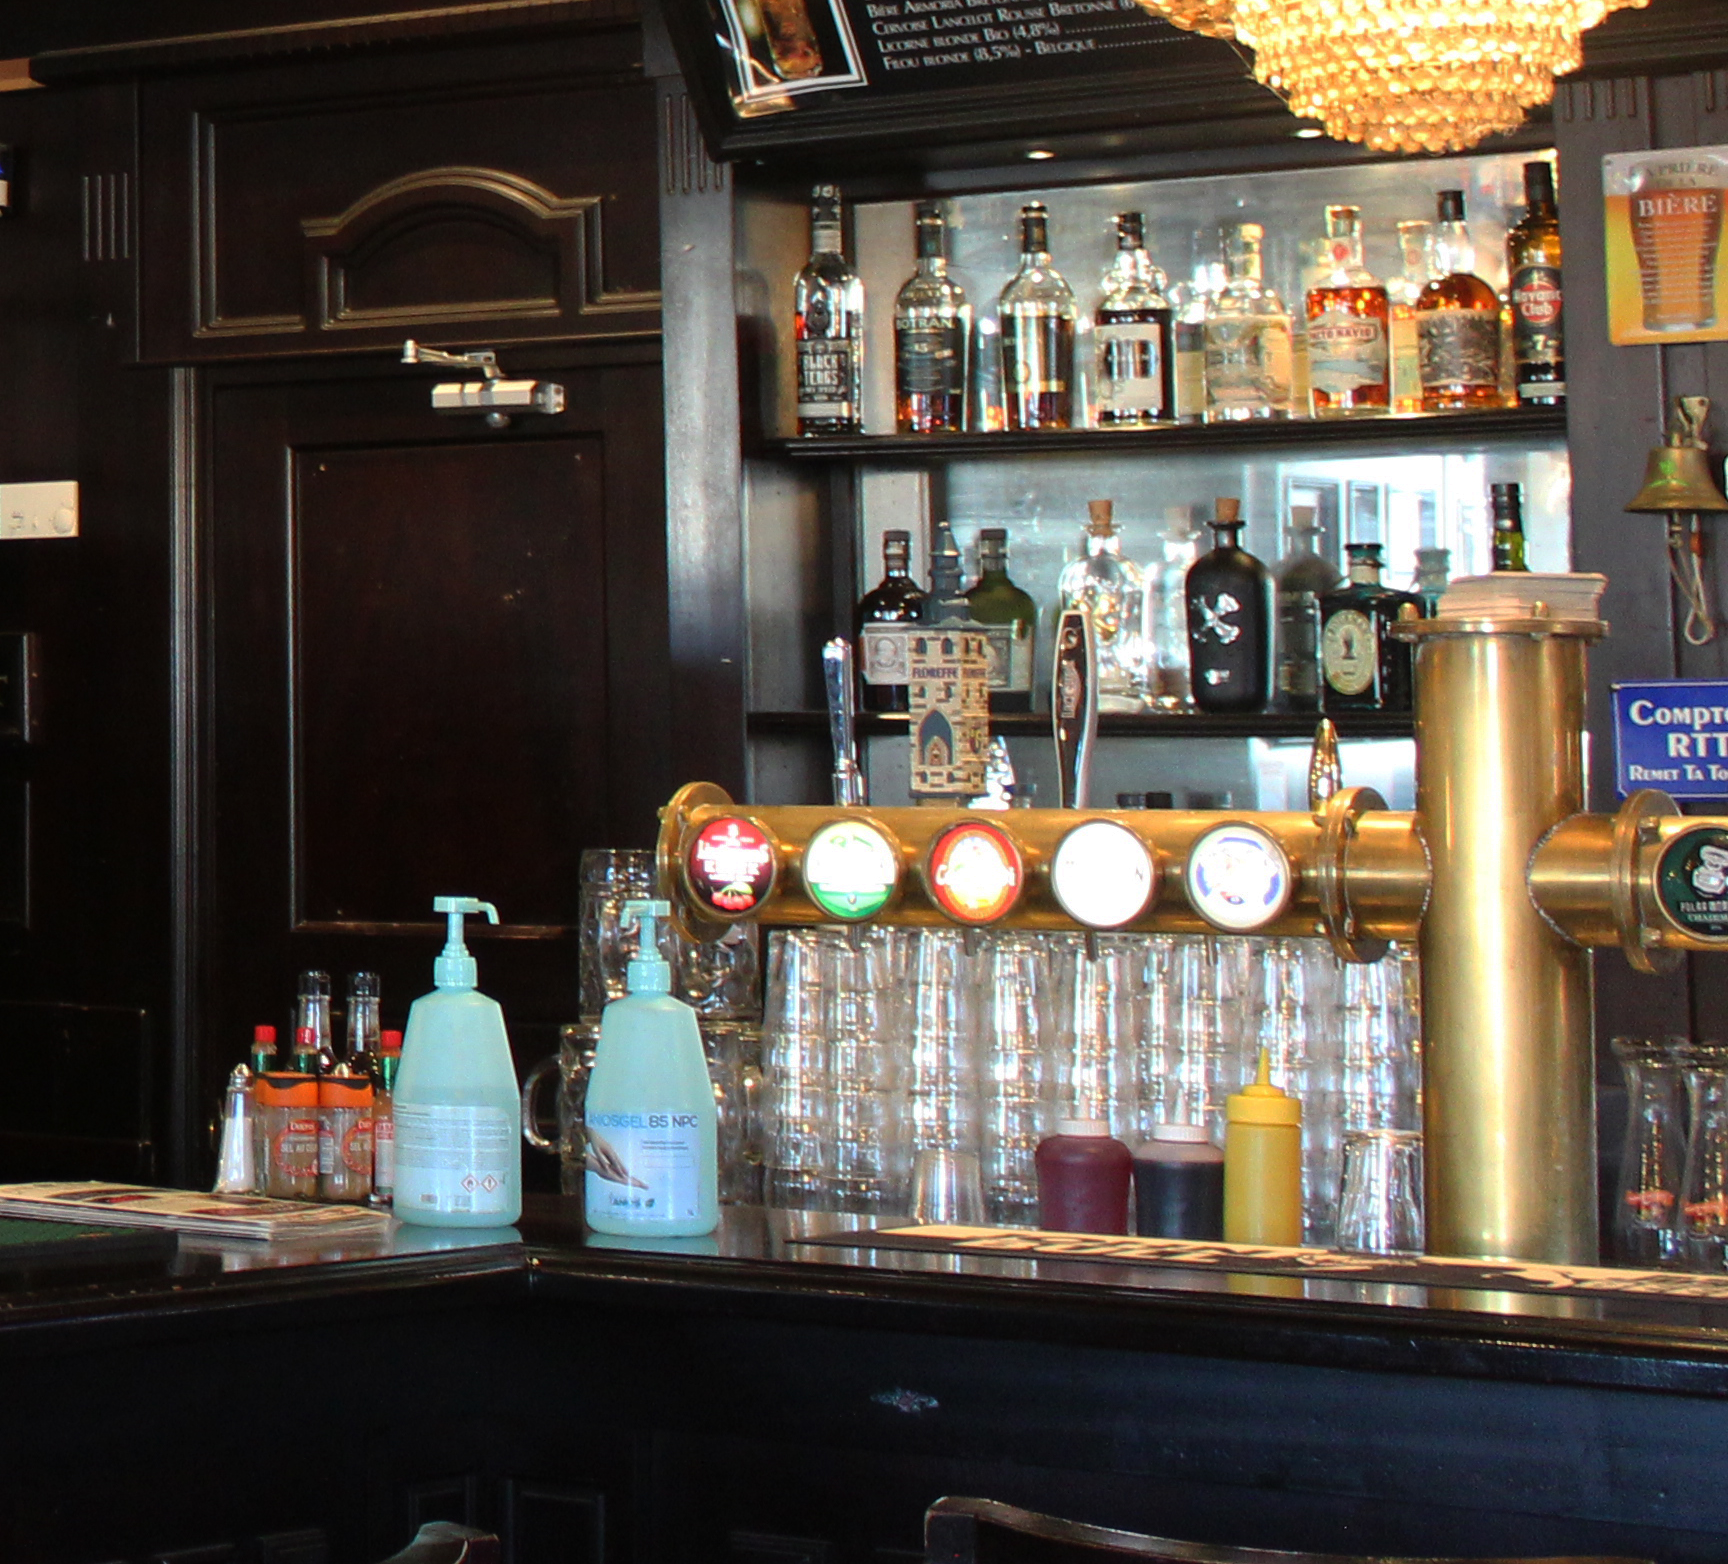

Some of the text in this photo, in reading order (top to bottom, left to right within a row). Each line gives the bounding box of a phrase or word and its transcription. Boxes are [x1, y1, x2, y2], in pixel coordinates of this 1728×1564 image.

[1638, 193, 1717, 217] BIÈRE
[648, 1115, 698, 1128] 85 NPC
